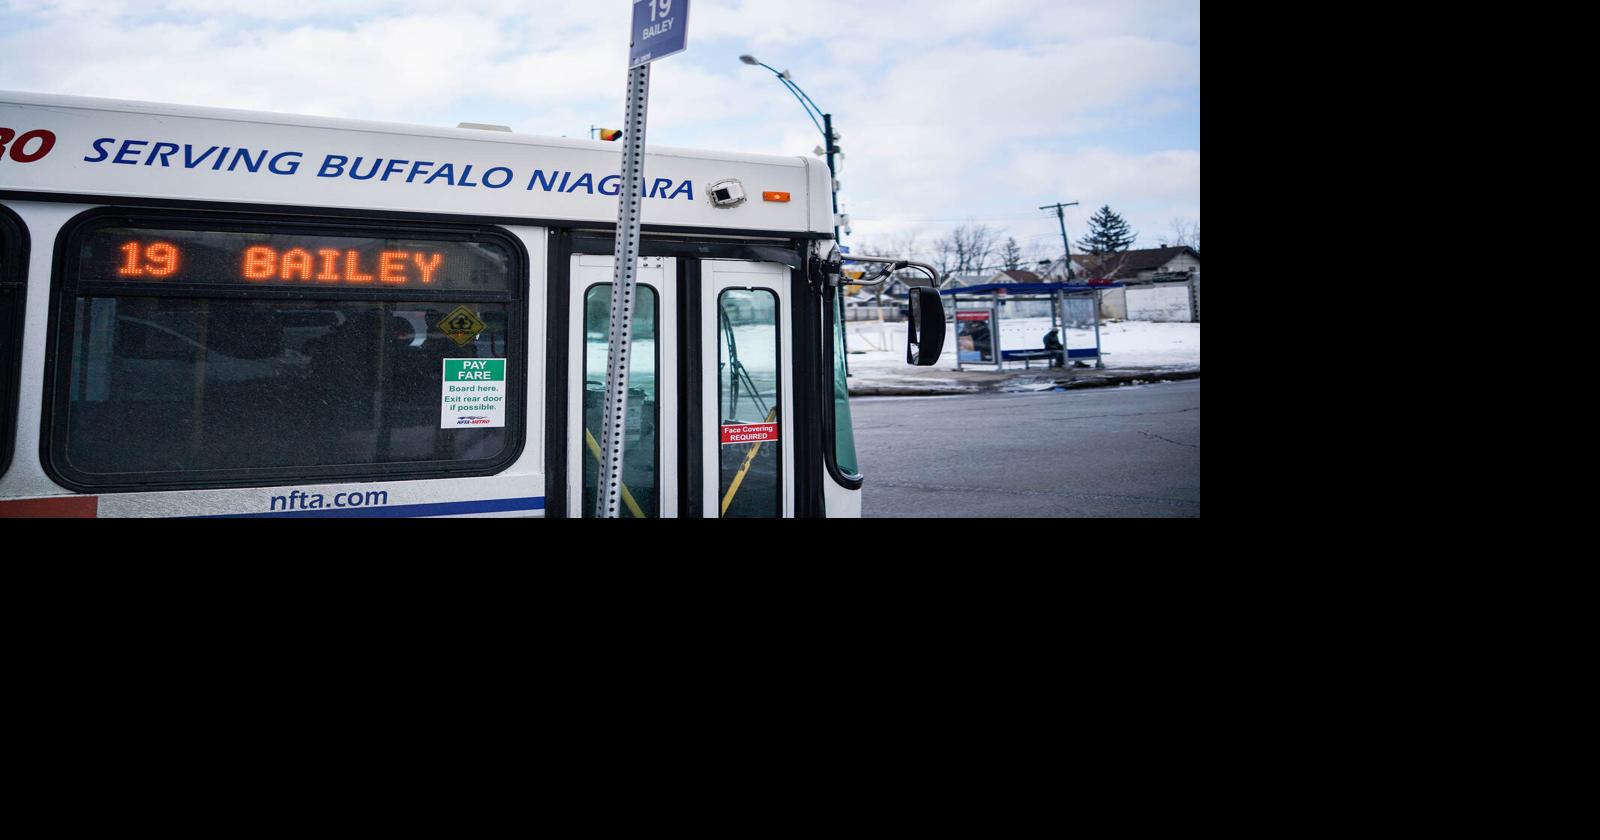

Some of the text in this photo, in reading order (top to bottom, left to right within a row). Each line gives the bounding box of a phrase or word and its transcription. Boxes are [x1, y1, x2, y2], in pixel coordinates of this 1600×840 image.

[643, 17, 674, 40] BAILEY
[84, 138, 694, 201] SERVING BUFFALO NIAGRA
[119, 241, 442, 284] 19 BAILEY
[458, 371, 491, 379] FARE
[463, 361, 487, 369] PAY
[458, 404, 496, 412] possible.
[270, 490, 388, 511] nfta.com
